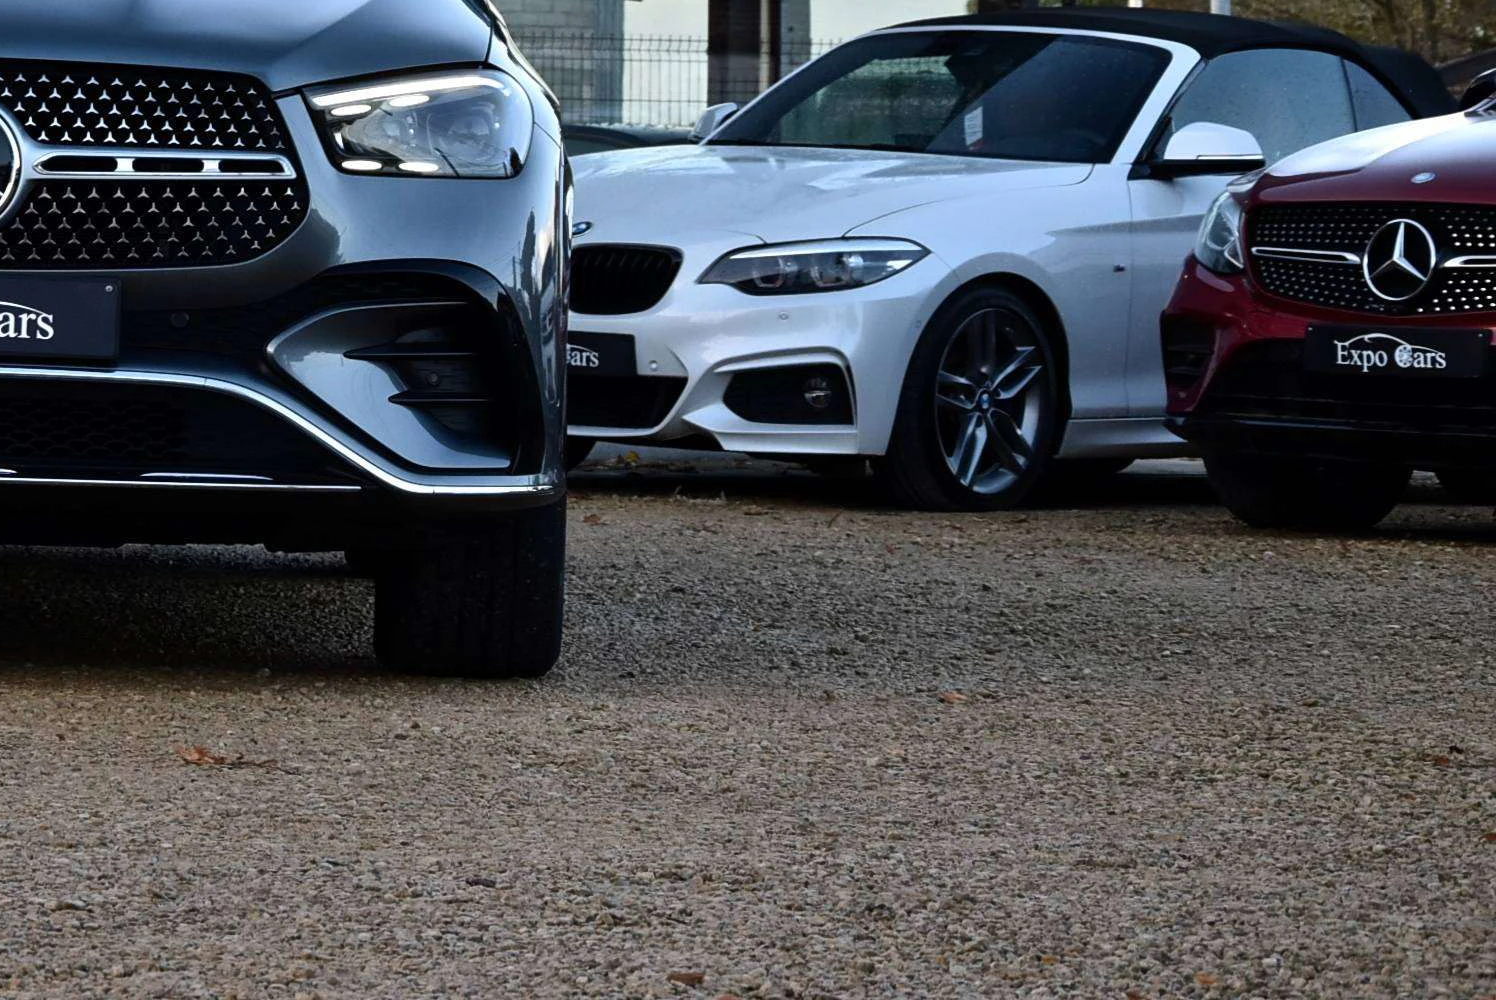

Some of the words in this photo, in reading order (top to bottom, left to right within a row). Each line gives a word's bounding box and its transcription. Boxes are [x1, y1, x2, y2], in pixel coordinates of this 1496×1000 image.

[566, 349, 599, 368] ars
[1335, 342, 1388, 372] Expo
[1394, 344, 1447, 369] Cars
